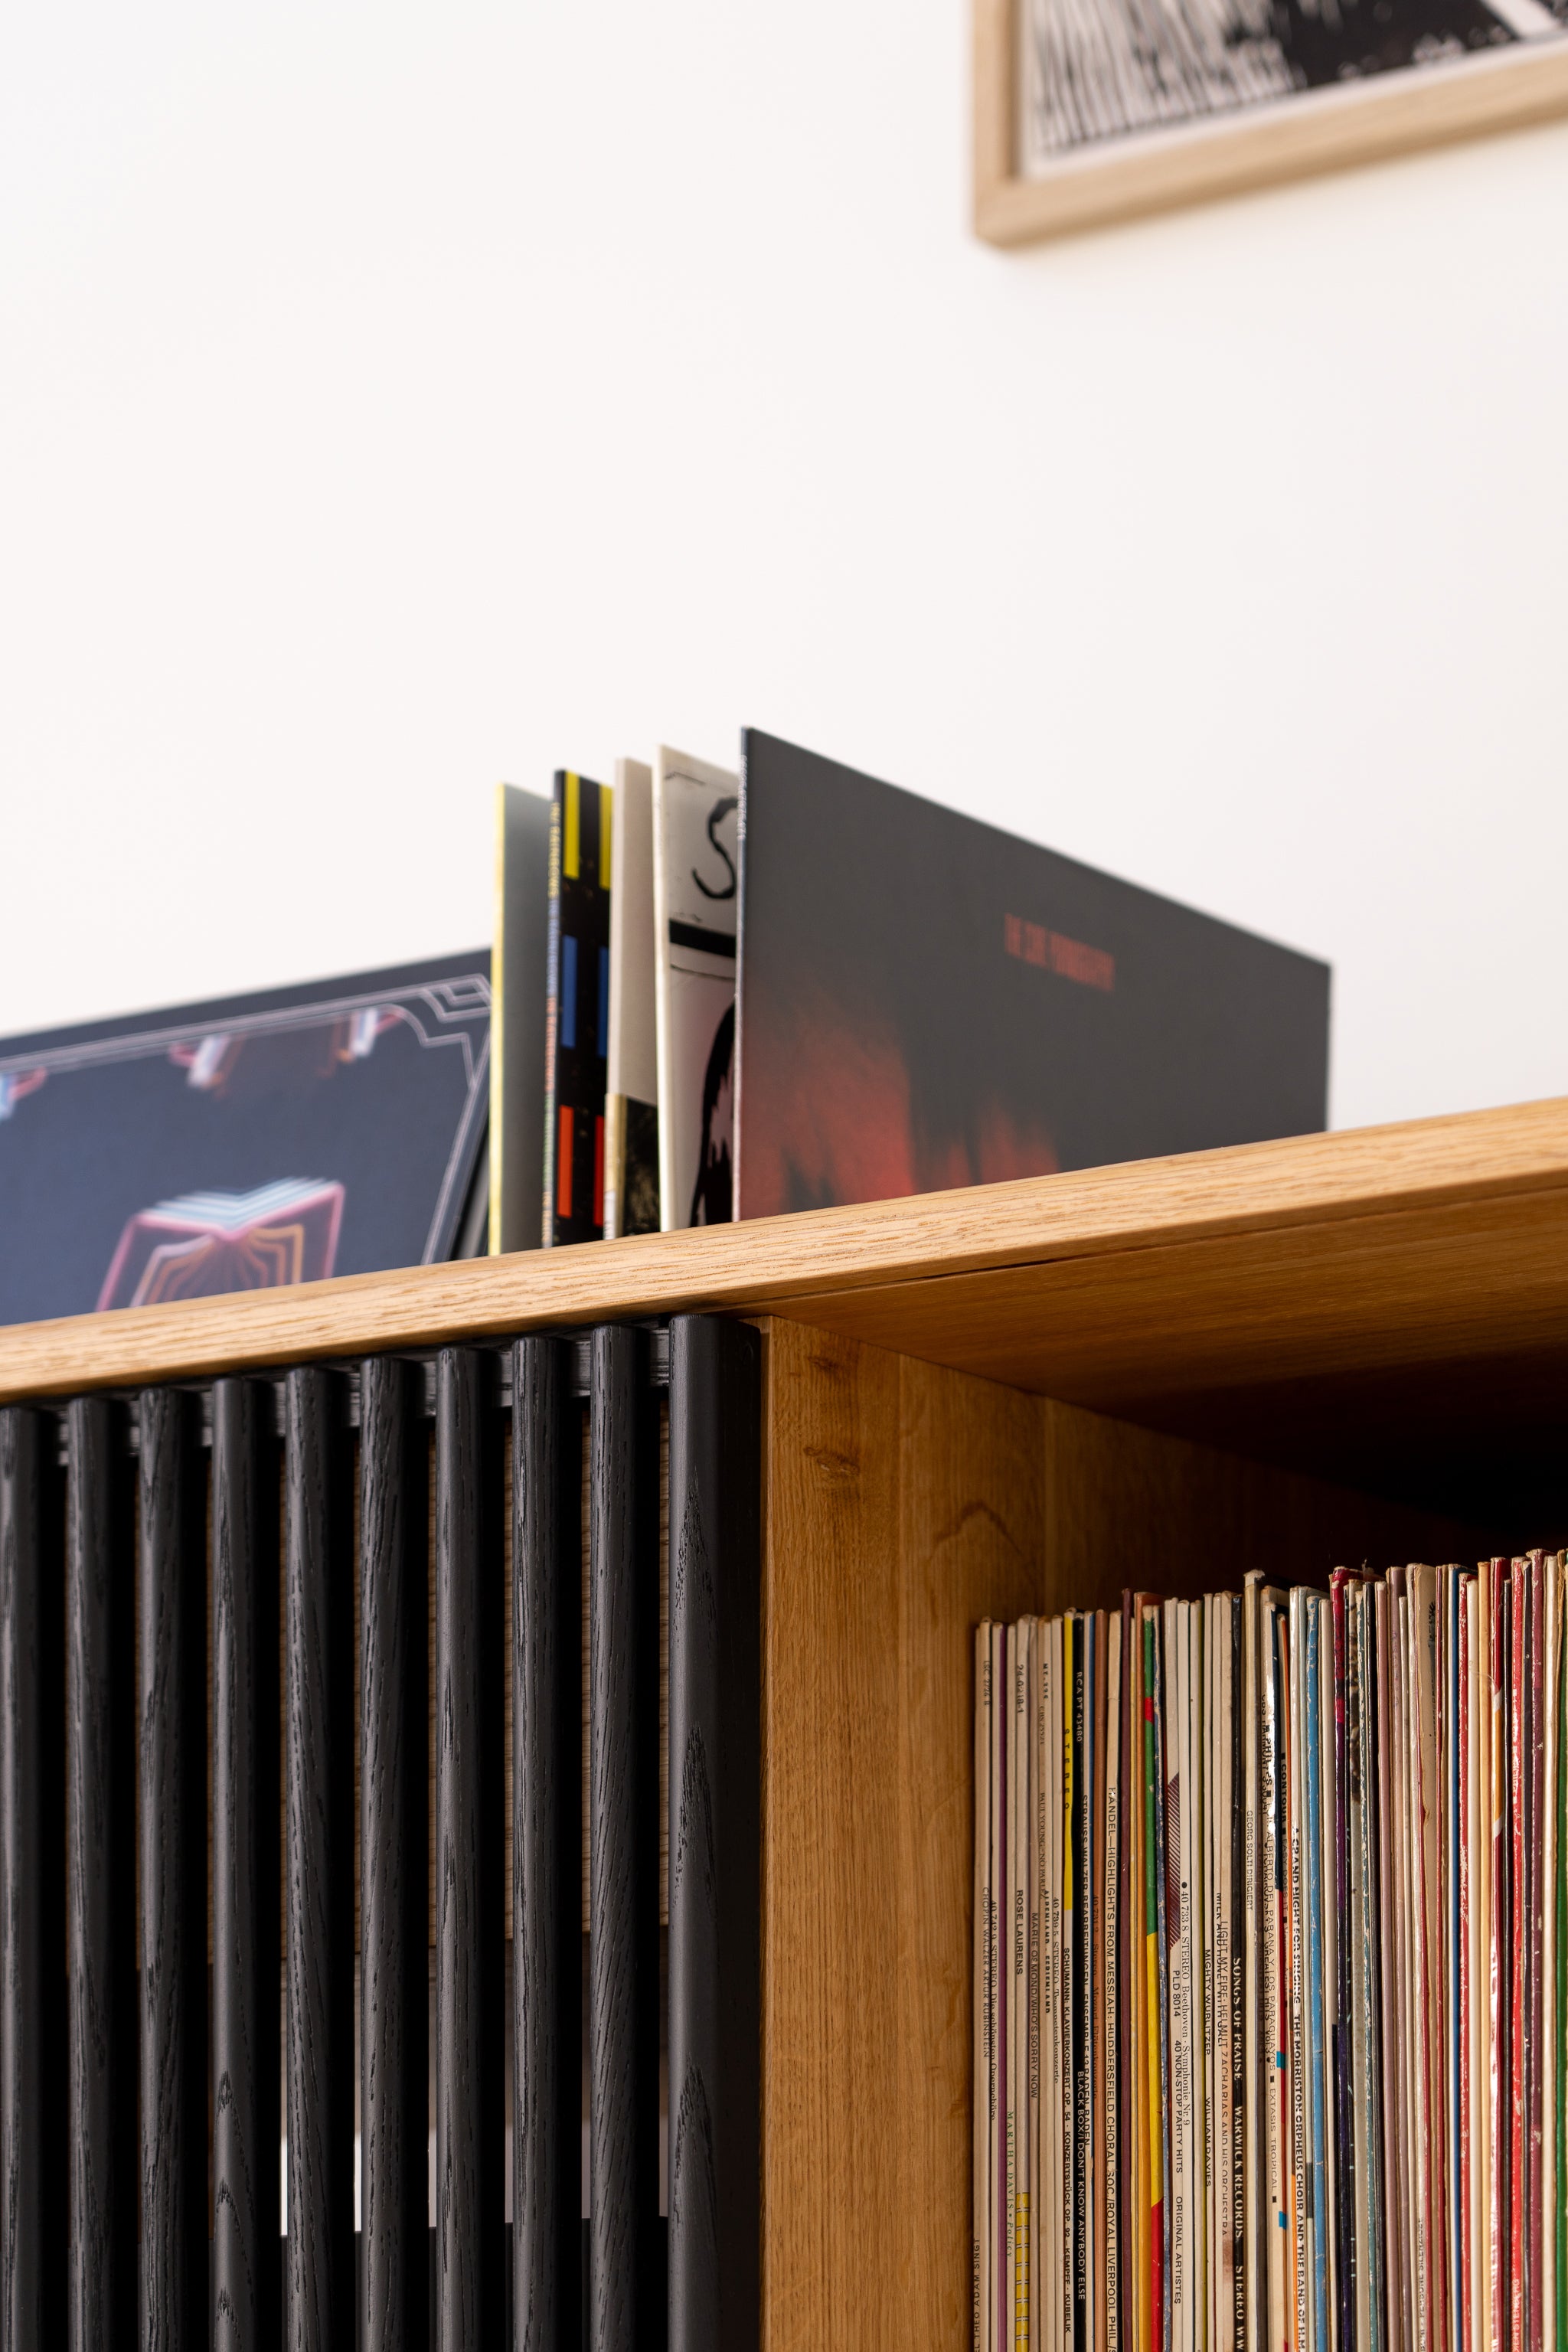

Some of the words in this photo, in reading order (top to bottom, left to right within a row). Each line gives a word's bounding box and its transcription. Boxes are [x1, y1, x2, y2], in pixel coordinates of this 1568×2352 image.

[1076, 1697, 1083, 1710] PT
[1040, 1853, 1046, 1867] NO
[1181, 1891, 1188, 1903] 40
[1283, 1903, 1288, 1913] IT
[1221, 1956, 1228, 1973] MY
[1269, 1958, 1275, 1967] Y
[1234, 2010, 1242, 2027] OF
[1174, 2040, 1181, 2053] 40
[1234, 2033, 1243, 2081] PRAISE
[1181, 2045, 1191, 2101] Symphonie
[1065, 2111, 1070, 2122] 54
[1234, 2105, 1243, 2169] WARWICK
[1107, 2171, 1116, 2243] SOC./ROYAL
[1235, 2174, 1243, 2238] RECORDS
[1065, 2226, 1070, 2237] 92
[1174, 2252, 1183, 2305] ARTISTES
[1235, 2265, 1243, 2320] STEREO
[1298, 2308, 1305, 2324] OF
